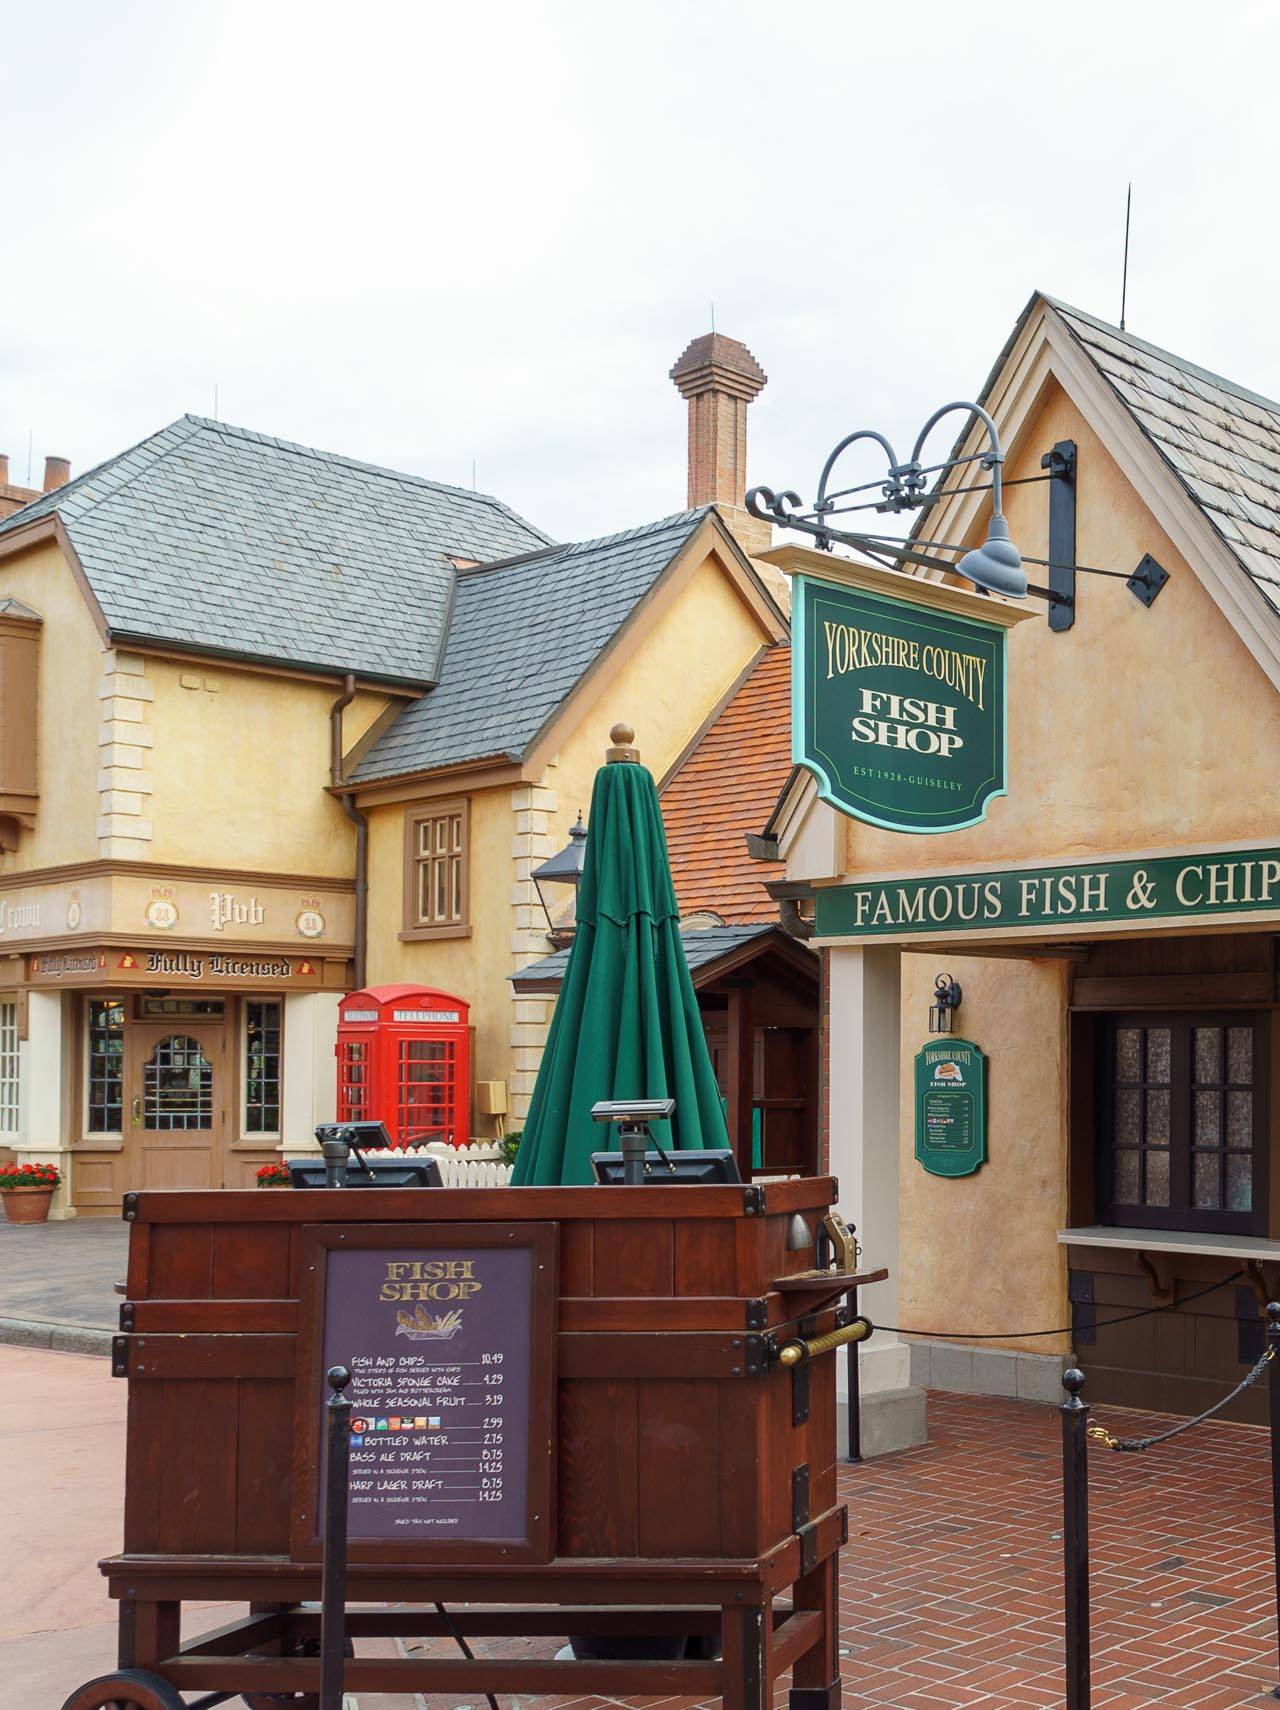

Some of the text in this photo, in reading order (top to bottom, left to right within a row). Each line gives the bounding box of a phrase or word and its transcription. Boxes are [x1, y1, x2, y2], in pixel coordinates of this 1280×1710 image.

[824, 621, 987, 711] YORKSHIRE COUNTY
[859, 688, 958, 730] FISH
[852, 717, 964, 758] SHOP
[853, 766, 874, 777] EST
[854, 881, 1002, 926] FAMOUS
[1018, 873, 1109, 916] FISH
[1126, 870, 1157, 910] &
[209, 892, 266, 931] Pub
[145, 952, 292, 979] Fully Licensed
[398, 1011, 456, 1020] TELEPHONE
[385, 1260, 475, 1280] FISH
[379, 1281, 482, 1301] SHOP
[352, 1353, 504, 1367] FISH AND CHIPS 10.49
[351, 1374, 503, 1387] VICTORIA SPONGE CAKE 4.29
[352, 1394, 503, 1408] WHOLE SEASONAL FRUIT 3.19
[483, 1417, 503, 1429] 2.99
[364, 1433, 503, 1447] BOTTLED WATER 2.75
[350, 1449, 503, 1462] BASS ALE DRAFT 8.75
[349, 1477, 503, 1491] HARP LAGER DRAFT 8.75
